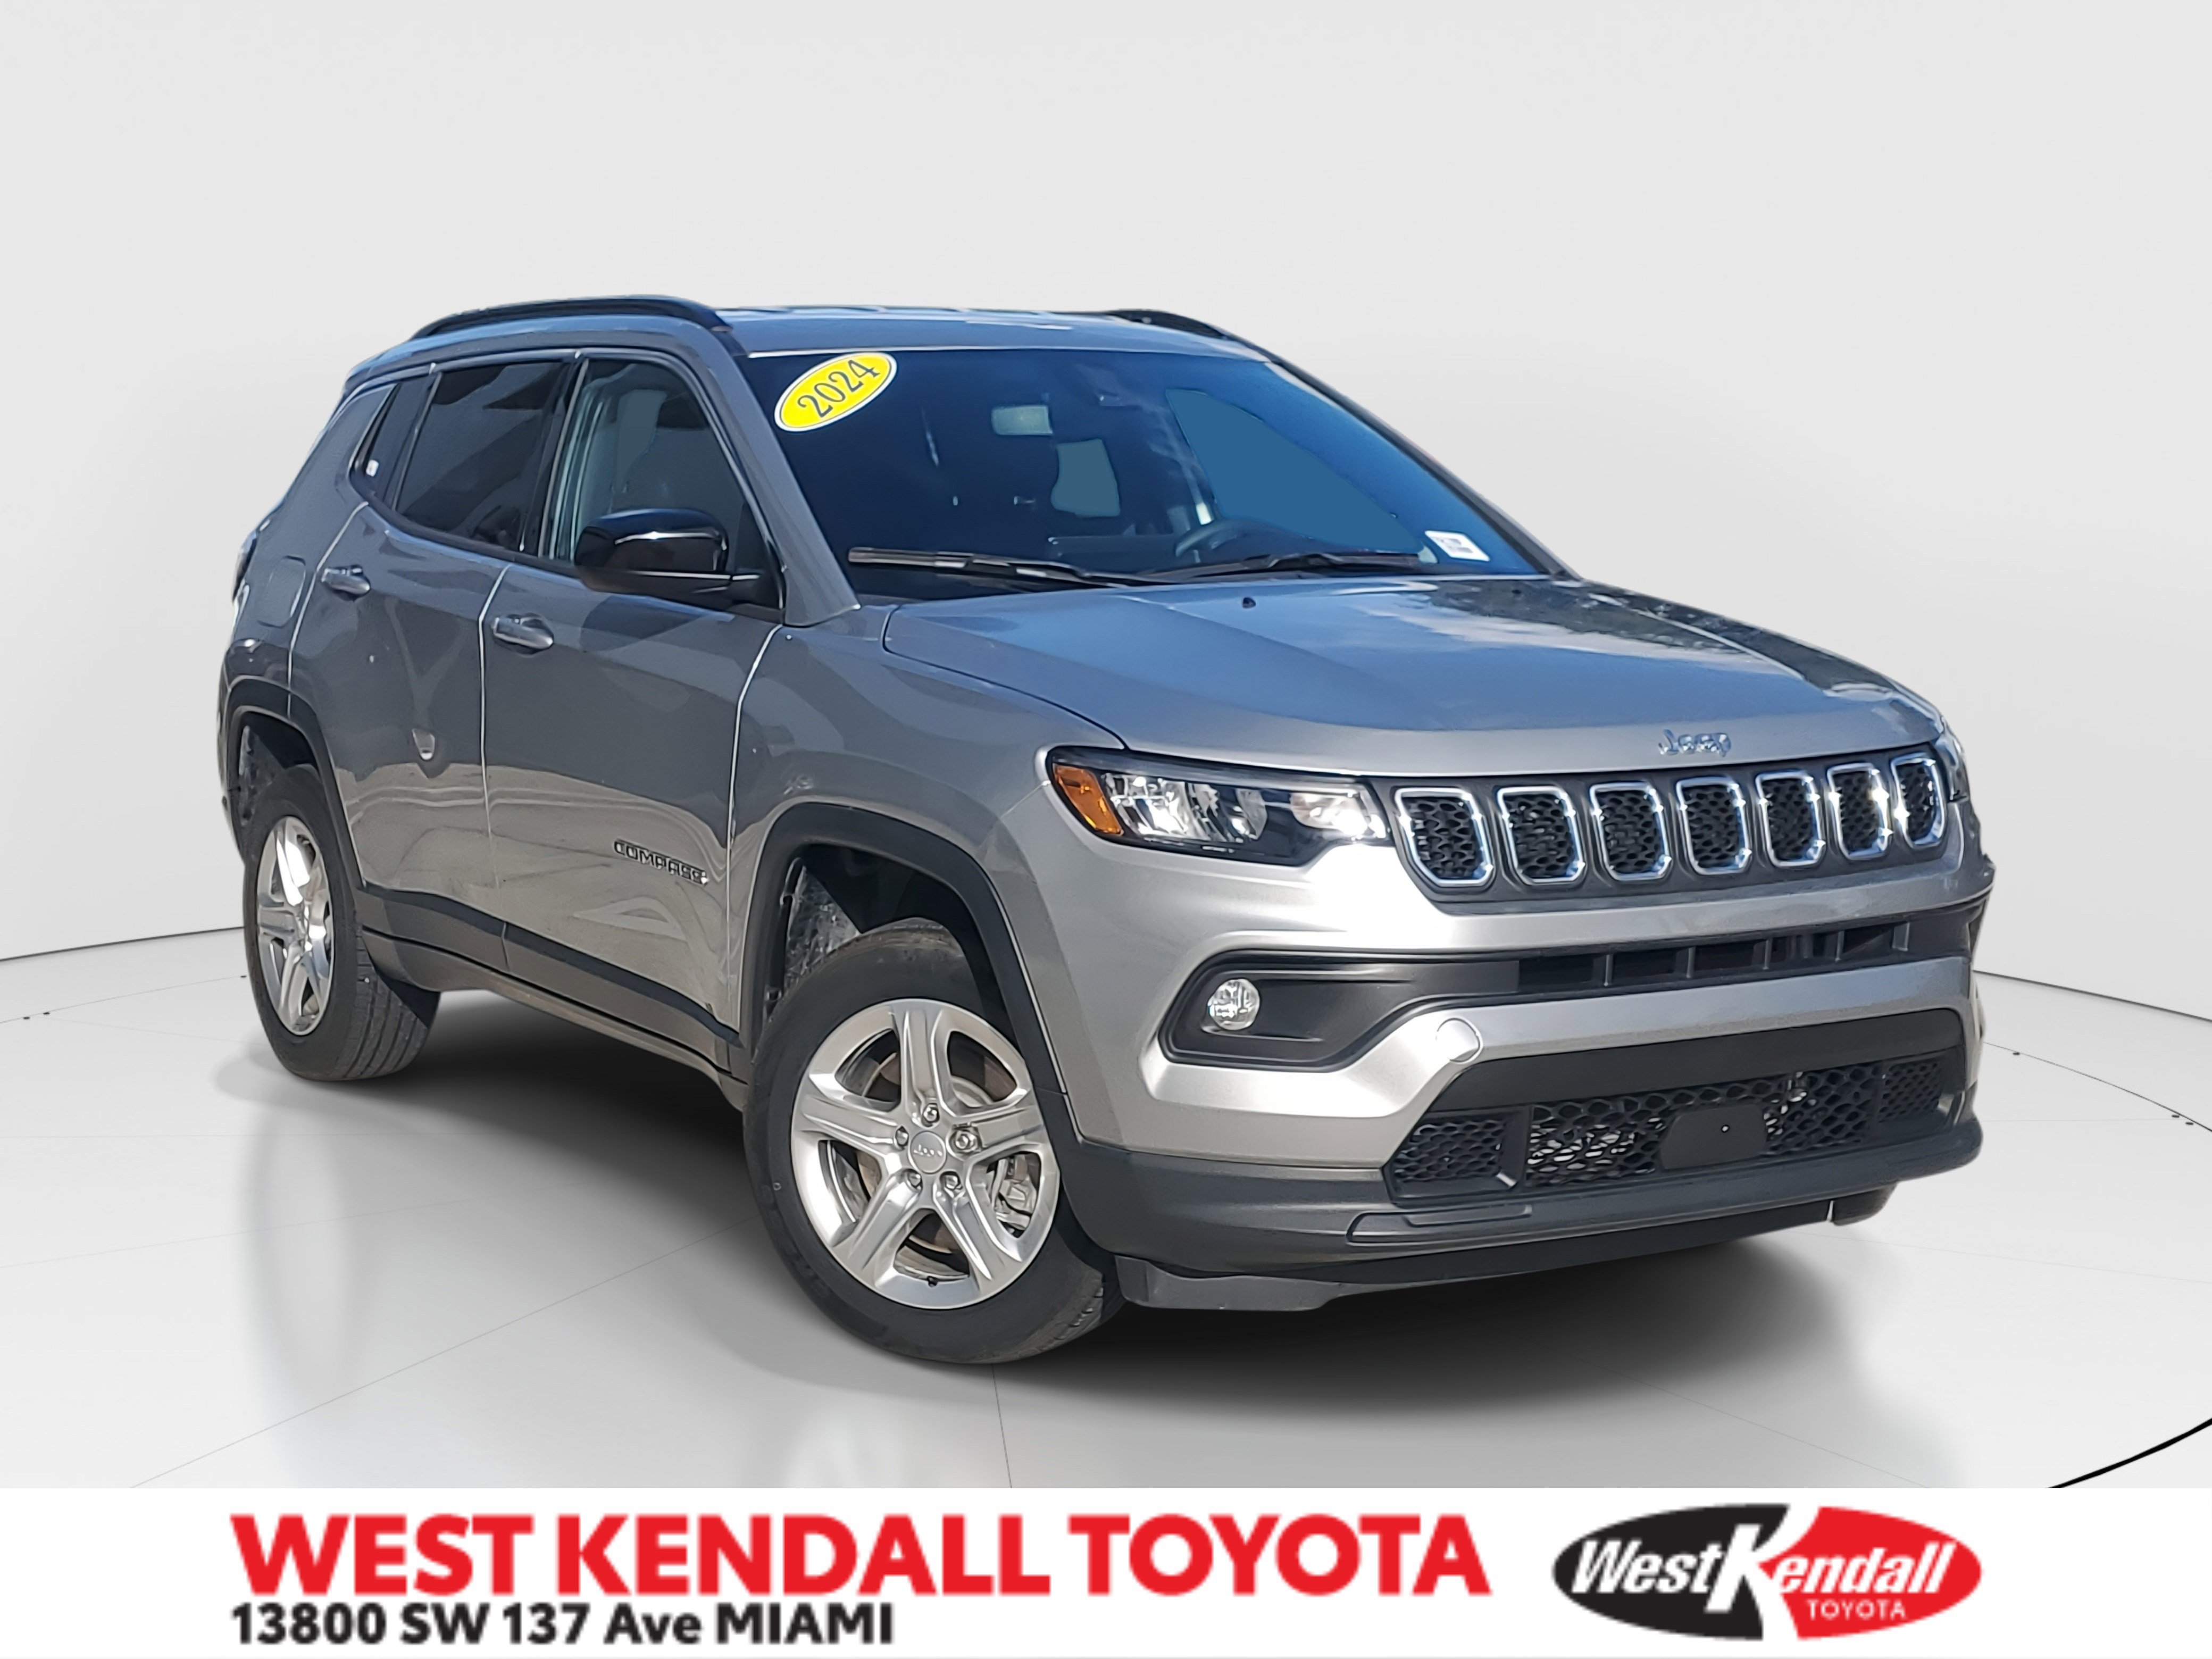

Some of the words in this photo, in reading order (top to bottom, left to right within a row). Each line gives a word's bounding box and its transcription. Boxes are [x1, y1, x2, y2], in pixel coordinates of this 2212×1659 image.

[797, 359, 880, 418] 2024
[1658, 729, 1732, 758] Jeep
[613, 838, 709, 886] COMPASS
